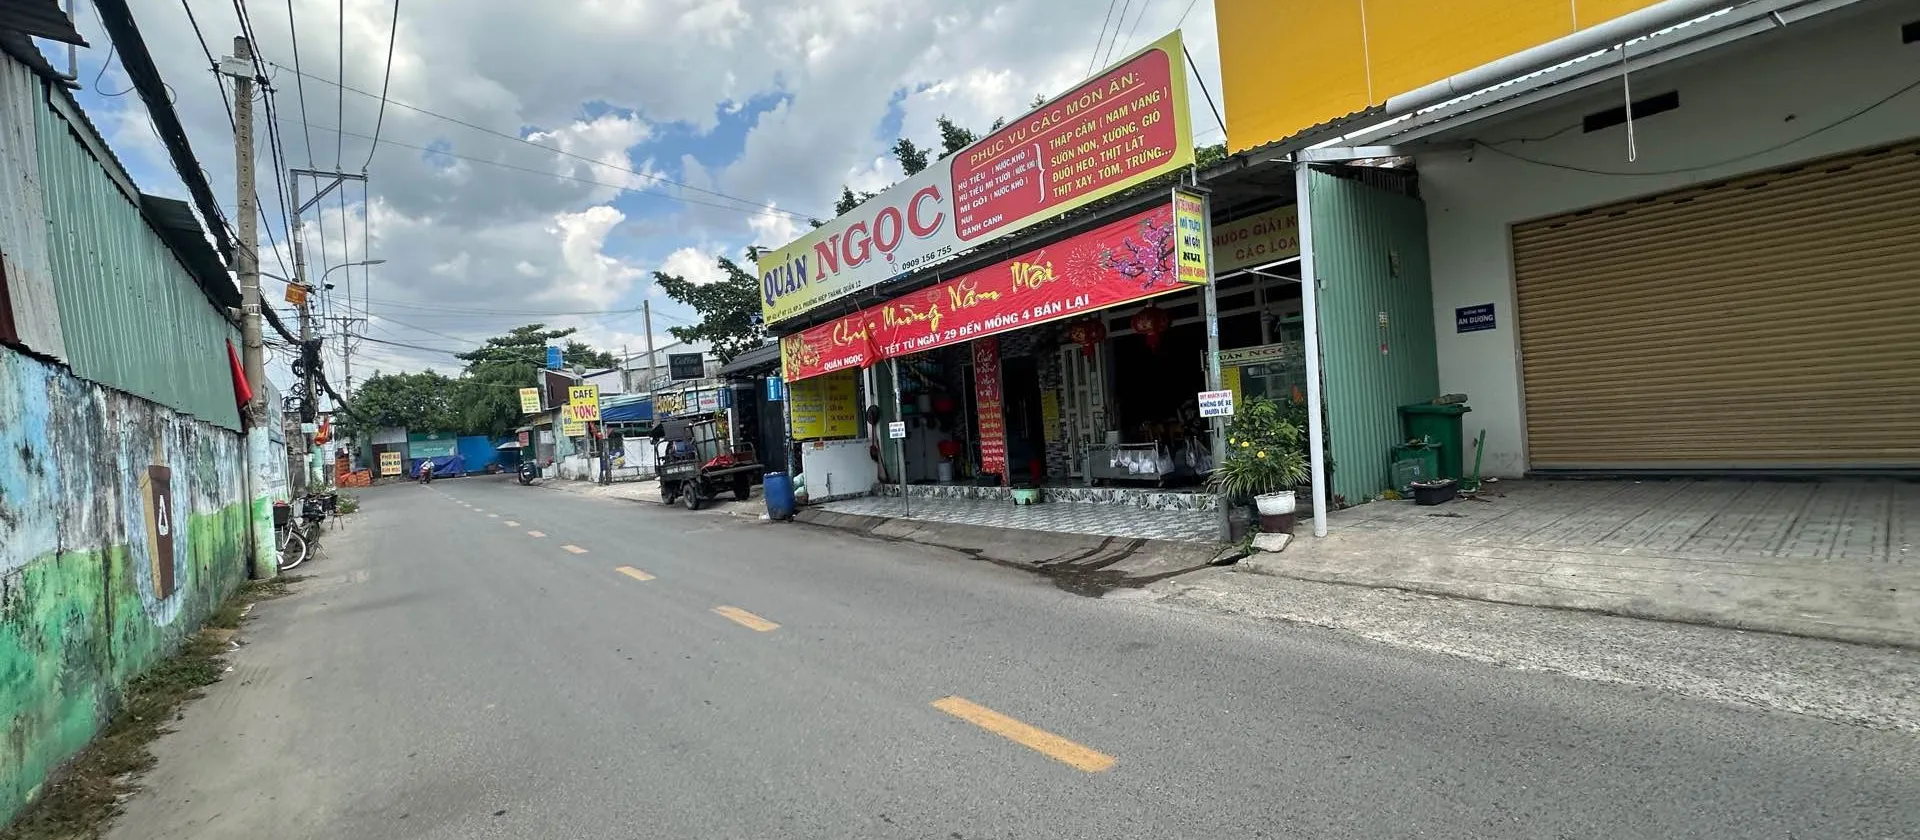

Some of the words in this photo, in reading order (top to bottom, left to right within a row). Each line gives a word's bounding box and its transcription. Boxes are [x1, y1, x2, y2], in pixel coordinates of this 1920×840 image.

[970, 139, 1004, 165] PHỤC
[1008, 128, 1026, 147] VỤ
[1031, 110, 1061, 132] CÁC
[1066, 87, 1103, 116] MÓN
[1109, 72, 1140, 95] ĂN:
[1105, 105, 1128, 125] NAM
[1131, 90, 1160, 112] VANG
[1077, 139, 1100, 157] NON,
[1141, 108, 1161, 127] GIÒ
[1076, 157, 1098, 173] HEO,
[1099, 145, 1122, 162] THỊT
[1053, 182, 1073, 198] THỊT
[1075, 174, 1096, 190] XAY,
[1098, 162, 1123, 180] TÔM,
[961, 215, 973, 226] NUI
[983, 213, 1003, 228] CANH
[763, 252, 808, 308] QUÁN
[813, 184, 945, 282] NGỌC
[902, 258, 920, 271] 0909
[922, 252, 936, 264] 156
[937, 245, 953, 258] 755
[1183, 251, 1201, 263] NUI
[948, 277, 1001, 312] Năm
[1011, 250, 1059, 294] Mới
[824, 358, 842, 371] QUÁN
[843, 353, 864, 368] NGỌC
[885, 341, 900, 355] TẾT
[917, 332, 941, 347] NGÀY
[944, 329, 957, 341] 29
[959, 319, 982, 337] ĐẾN
[1022, 309, 1030, 320] 4
[1034, 299, 1061, 318] BÁN
[1066, 293, 1090, 309] LẠI
[1219, 352, 1242, 361] UÁN
